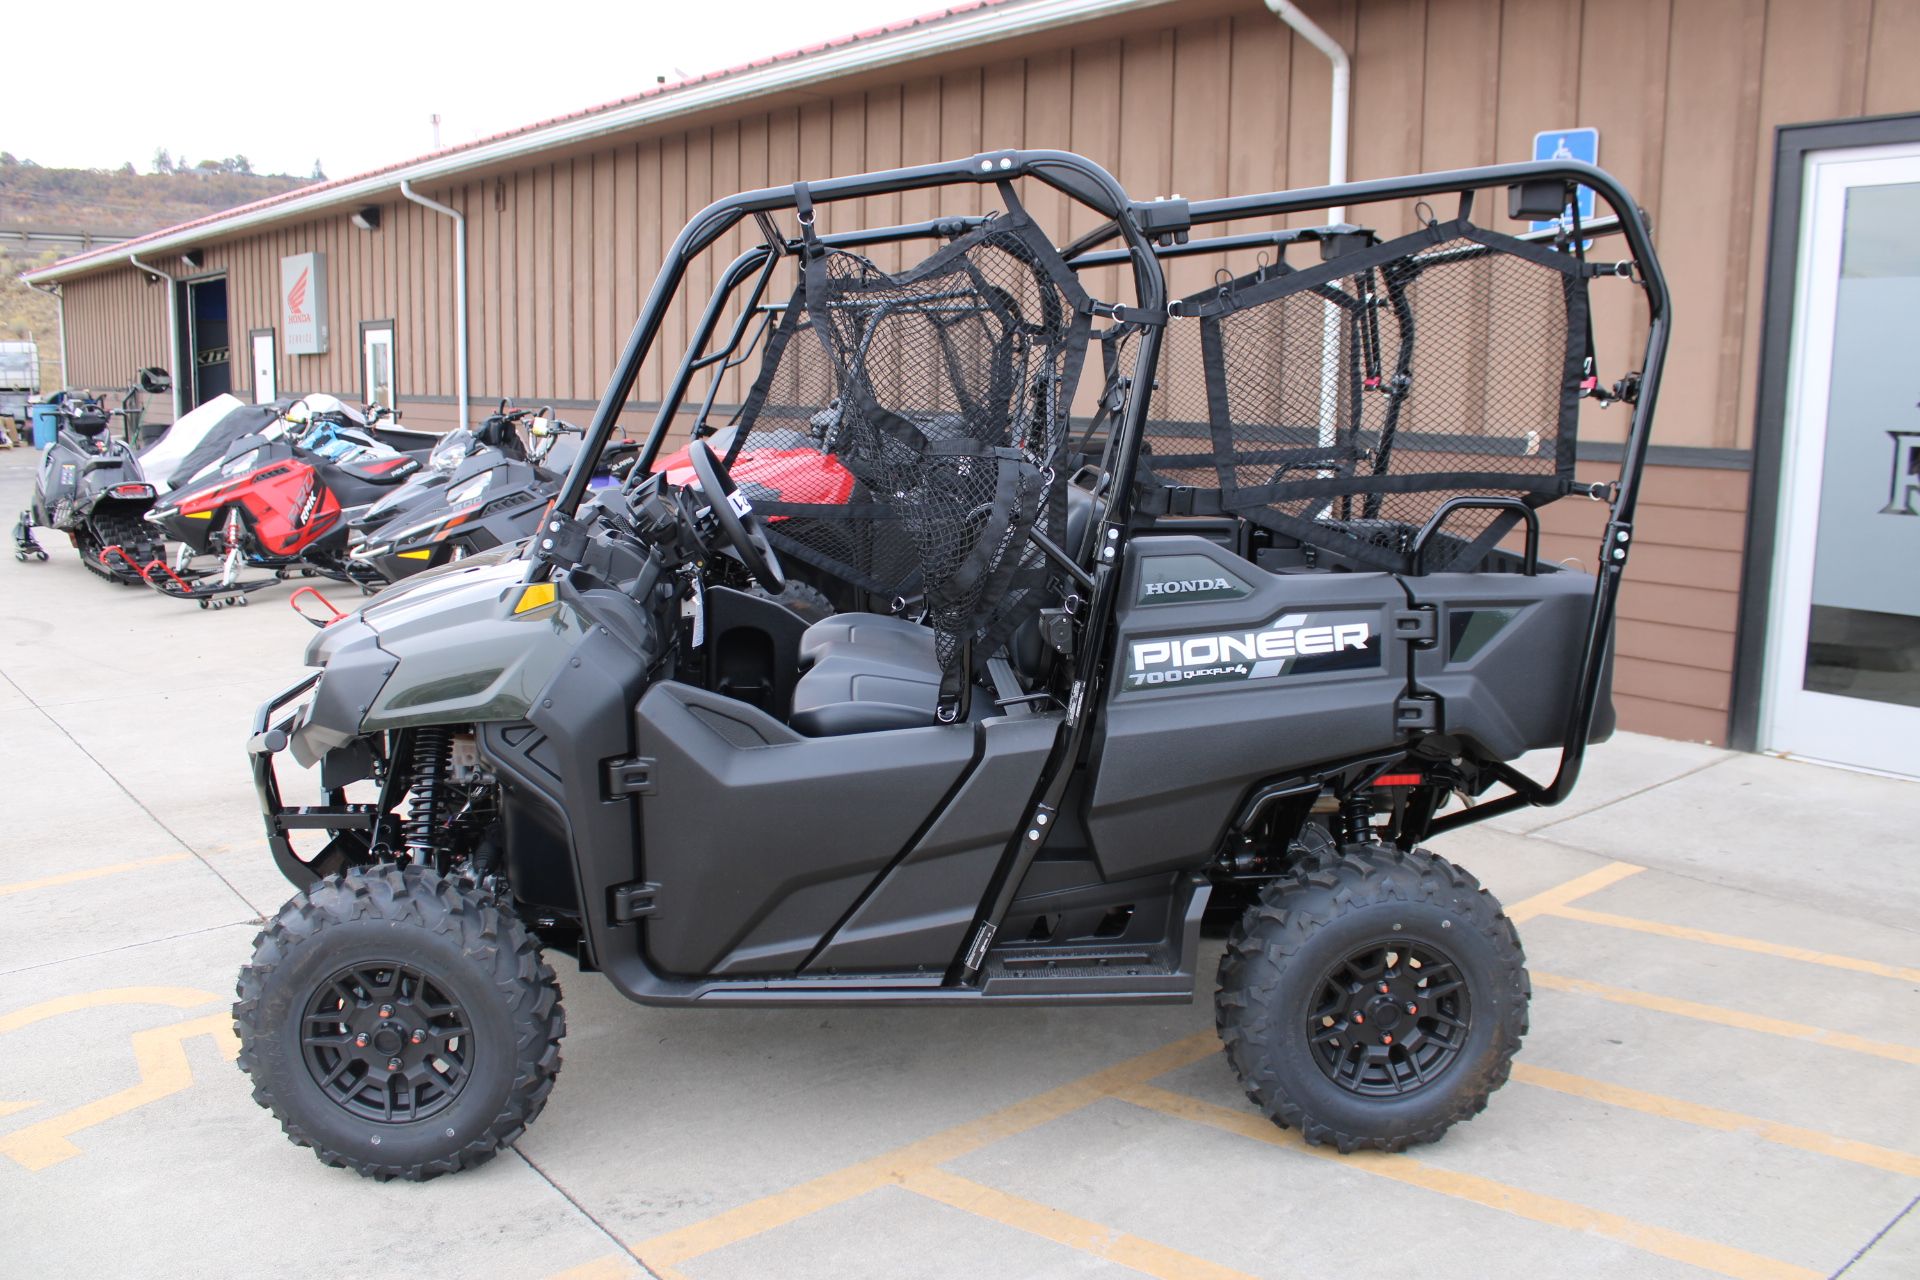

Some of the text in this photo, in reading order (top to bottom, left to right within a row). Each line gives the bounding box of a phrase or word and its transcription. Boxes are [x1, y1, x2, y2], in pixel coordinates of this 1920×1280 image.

[288, 313, 311, 324] HONDA
[391, 460, 418, 477] POLARIS
[300, 490, 317, 525] RMK
[1145, 577, 1231, 595] HONDA
[1133, 622, 1369, 671] PIONEER
[1128, 670, 1182, 685] 700
